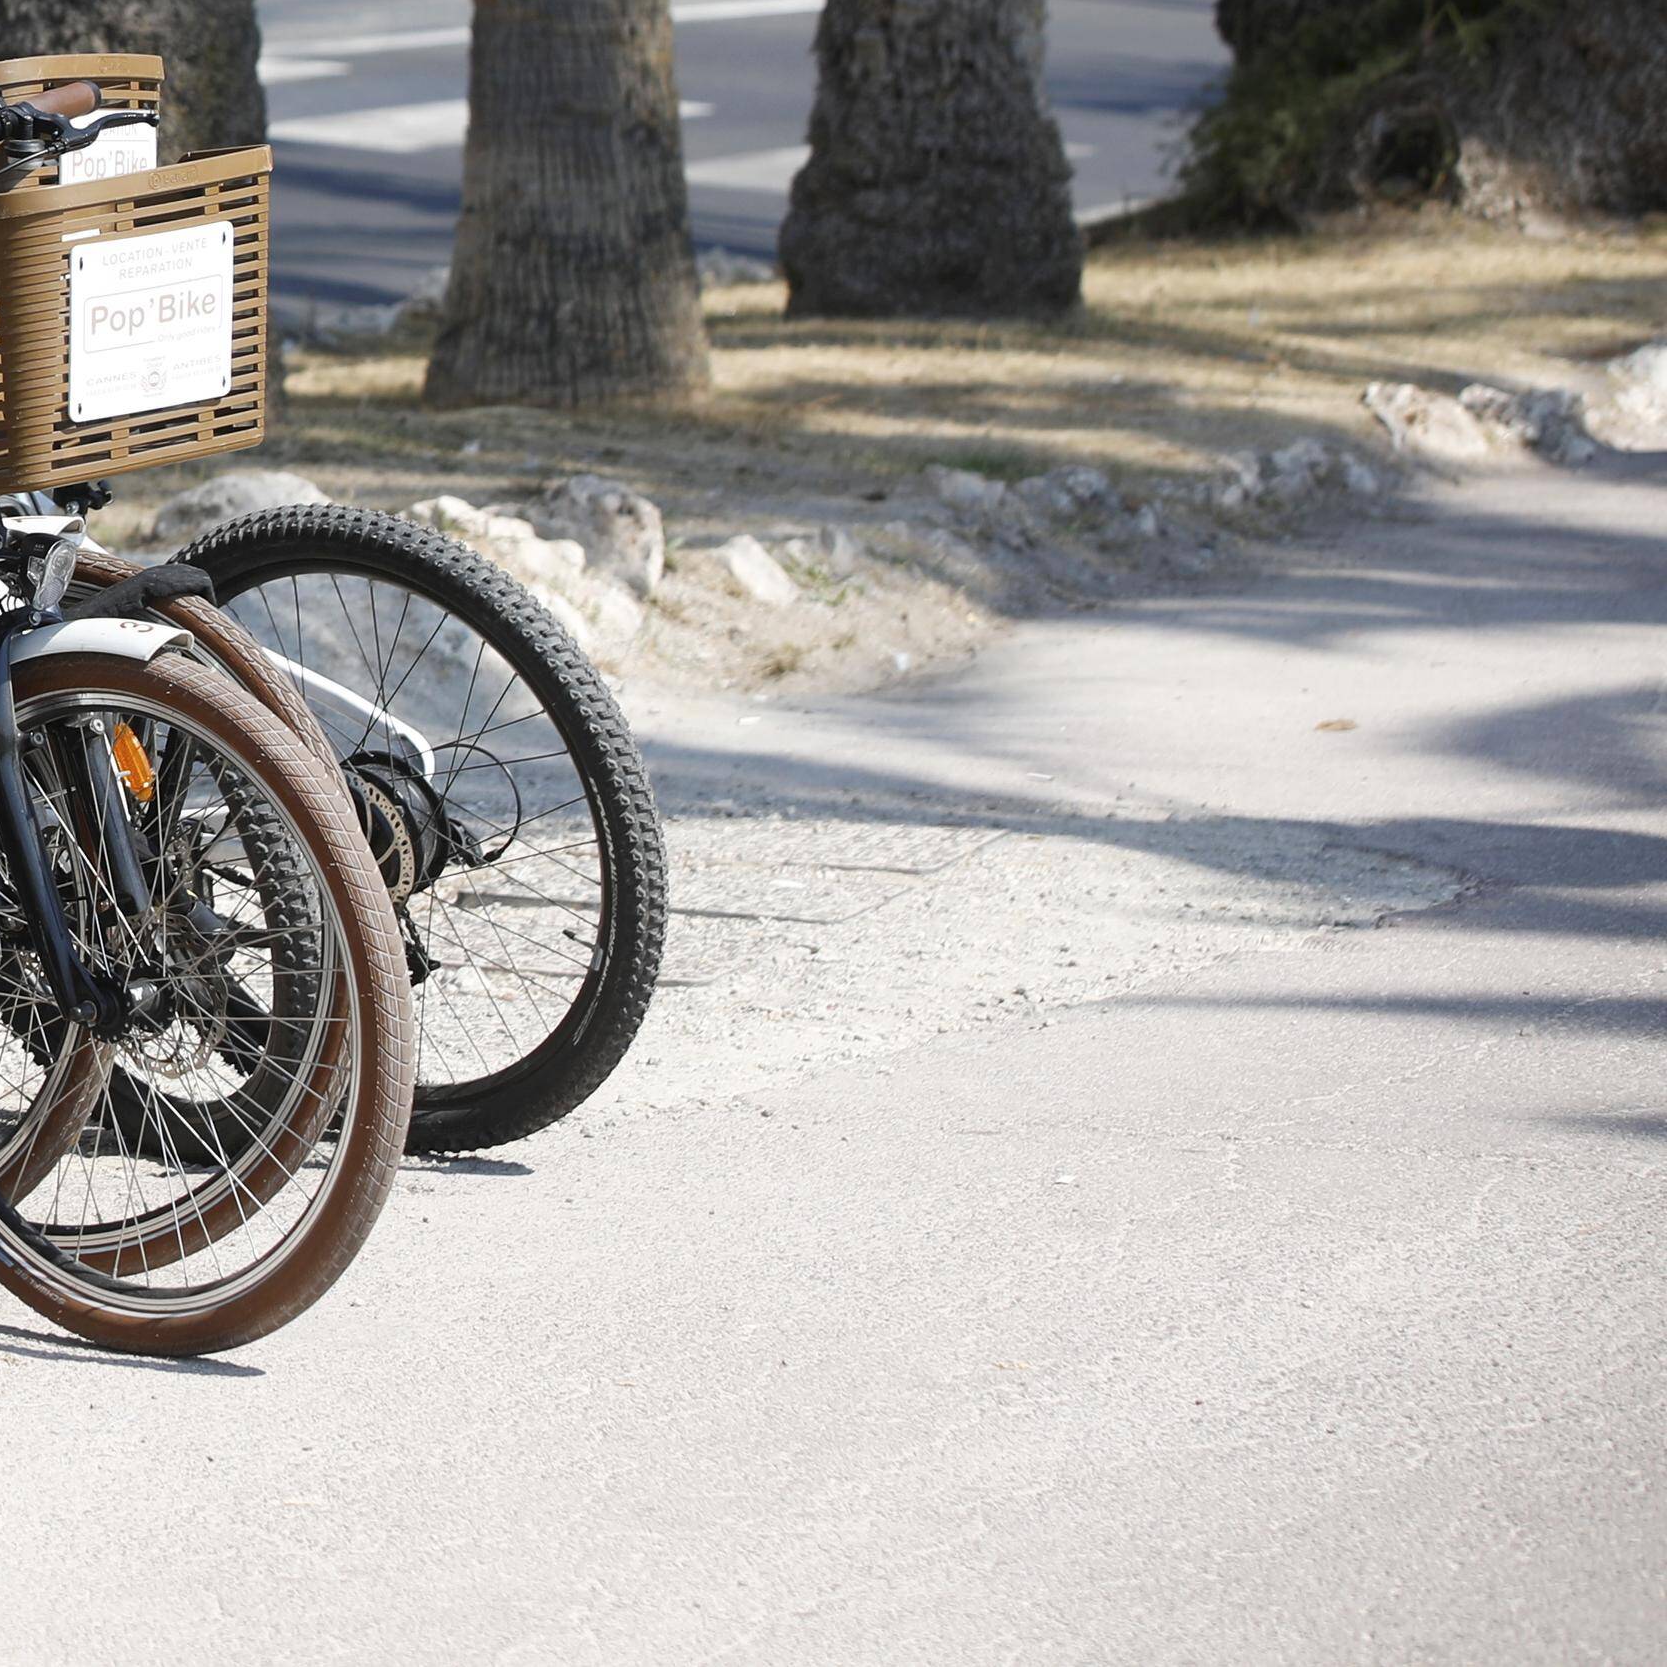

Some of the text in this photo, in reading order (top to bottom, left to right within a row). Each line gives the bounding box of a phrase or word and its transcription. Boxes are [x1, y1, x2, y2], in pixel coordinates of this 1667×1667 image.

[101, 245, 164, 267] LOCATION
[171, 236, 208, 255] VENTE
[118, 256, 194, 281] REPARATION
[91, 289, 216, 337] Pop'Bike
[85, 371, 138, 388] CANNES
